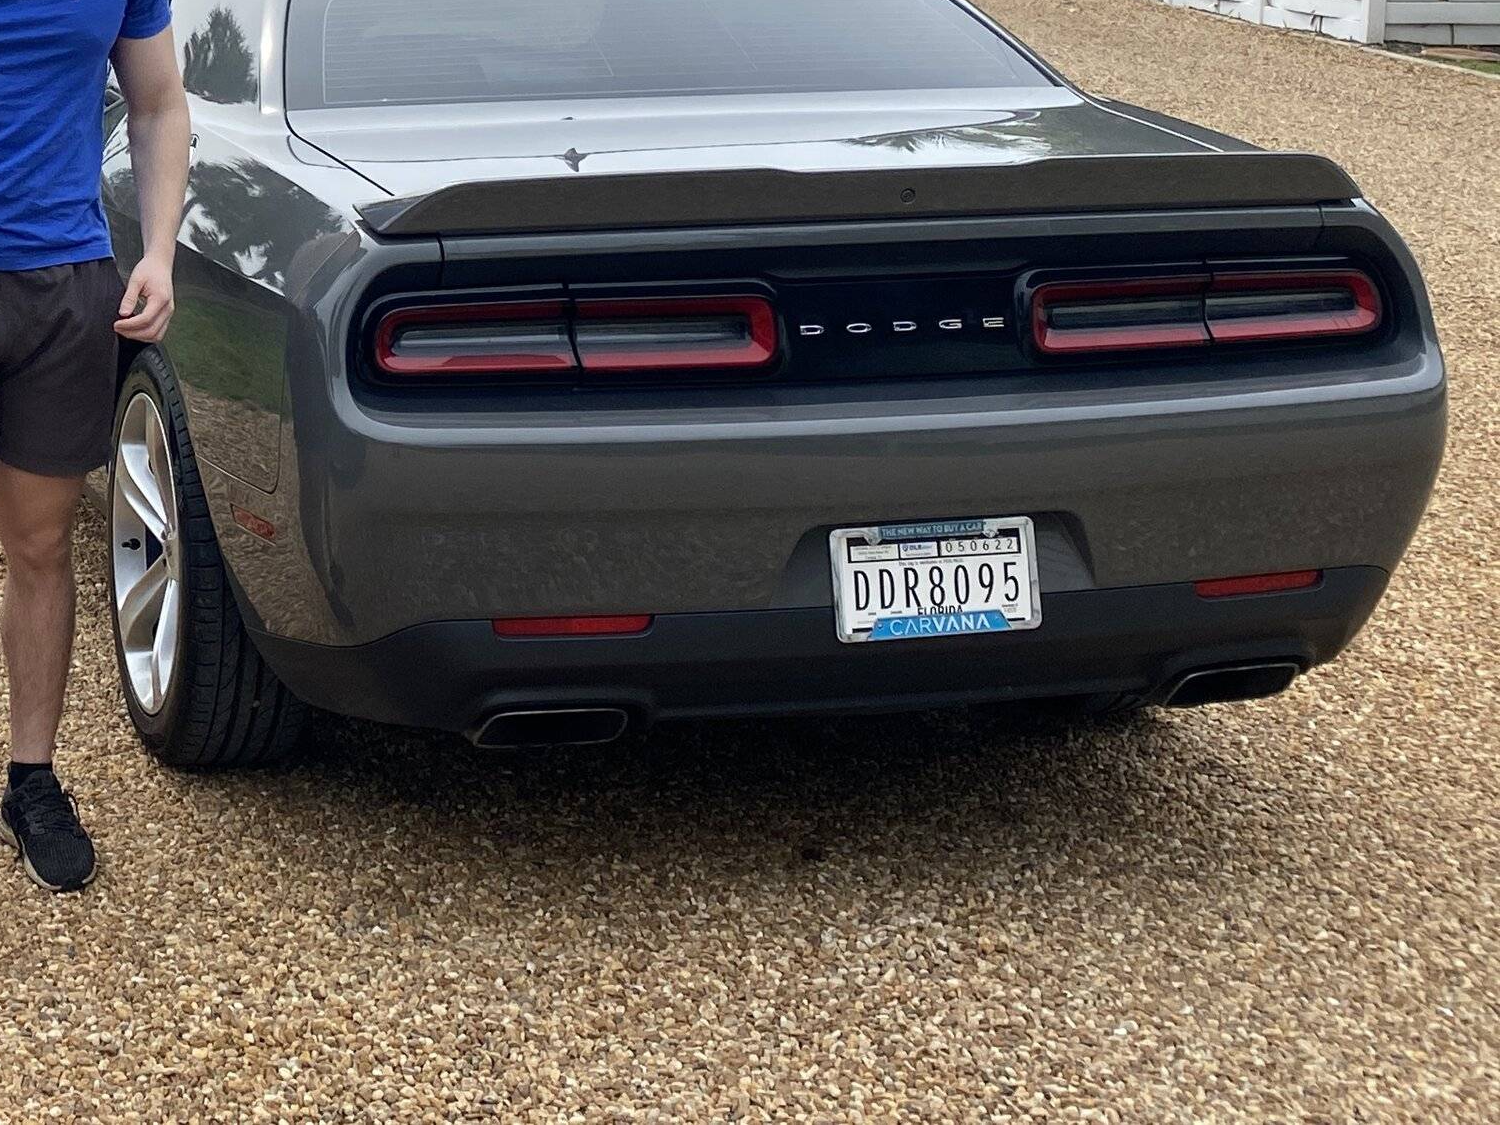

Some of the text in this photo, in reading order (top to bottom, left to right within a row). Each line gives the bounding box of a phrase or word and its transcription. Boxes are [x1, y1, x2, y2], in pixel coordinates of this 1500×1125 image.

[800, 317, 1004, 335] DODGE
[881, 528, 896, 536] THE
[897, 527, 915, 535] NEW
[916, 526, 932, 534] WAY
[932, 525, 943, 533] TO
[944, 524, 957, 532] BUY
[966, 522, 983, 531] CAR
[945, 538, 1014, 553] 050622
[853, 561, 1020, 611] DDR8095
[889, 613, 991, 636] CARVANA
